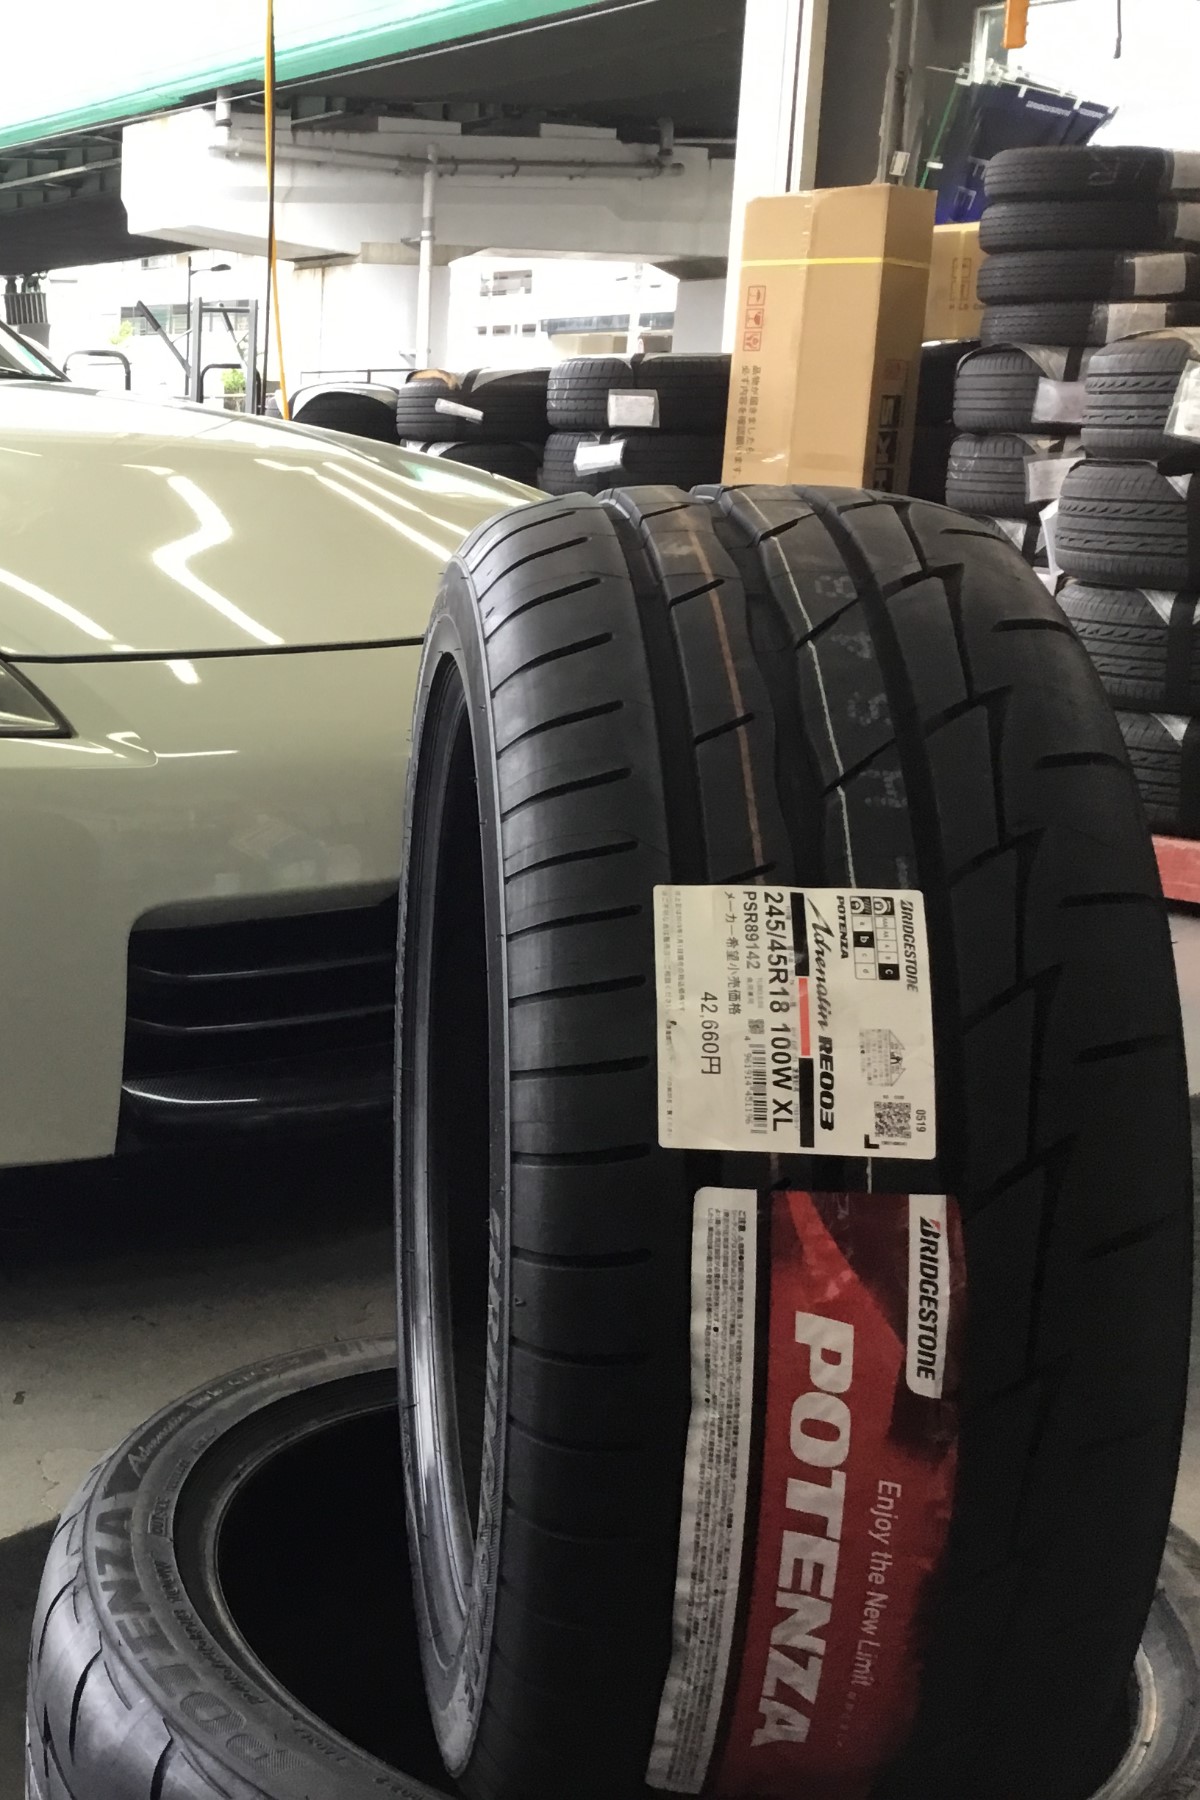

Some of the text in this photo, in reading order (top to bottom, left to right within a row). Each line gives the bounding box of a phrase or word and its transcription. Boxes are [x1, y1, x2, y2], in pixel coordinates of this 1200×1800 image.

[724, 890, 741, 1015] メーカー希望小売価格
[743, 891, 761, 969] PSR89142
[836, 895, 849, 959] POTENZA
[900, 899, 919, 992] BRIDGESTONE
[699, 991, 721, 1075] 42,660円
[764, 891, 793, 1131] 245/45R18 100W XL
[807, 898, 835, 1131] Adrenalin RE003
[916, 1109, 926, 1132] 0519
[916, 1216, 942, 1381] BRIDGESTONE
[750, 1310, 855, 1747] POTENZA
[850, 1480, 902, 1687] Enjoy the New Limit
